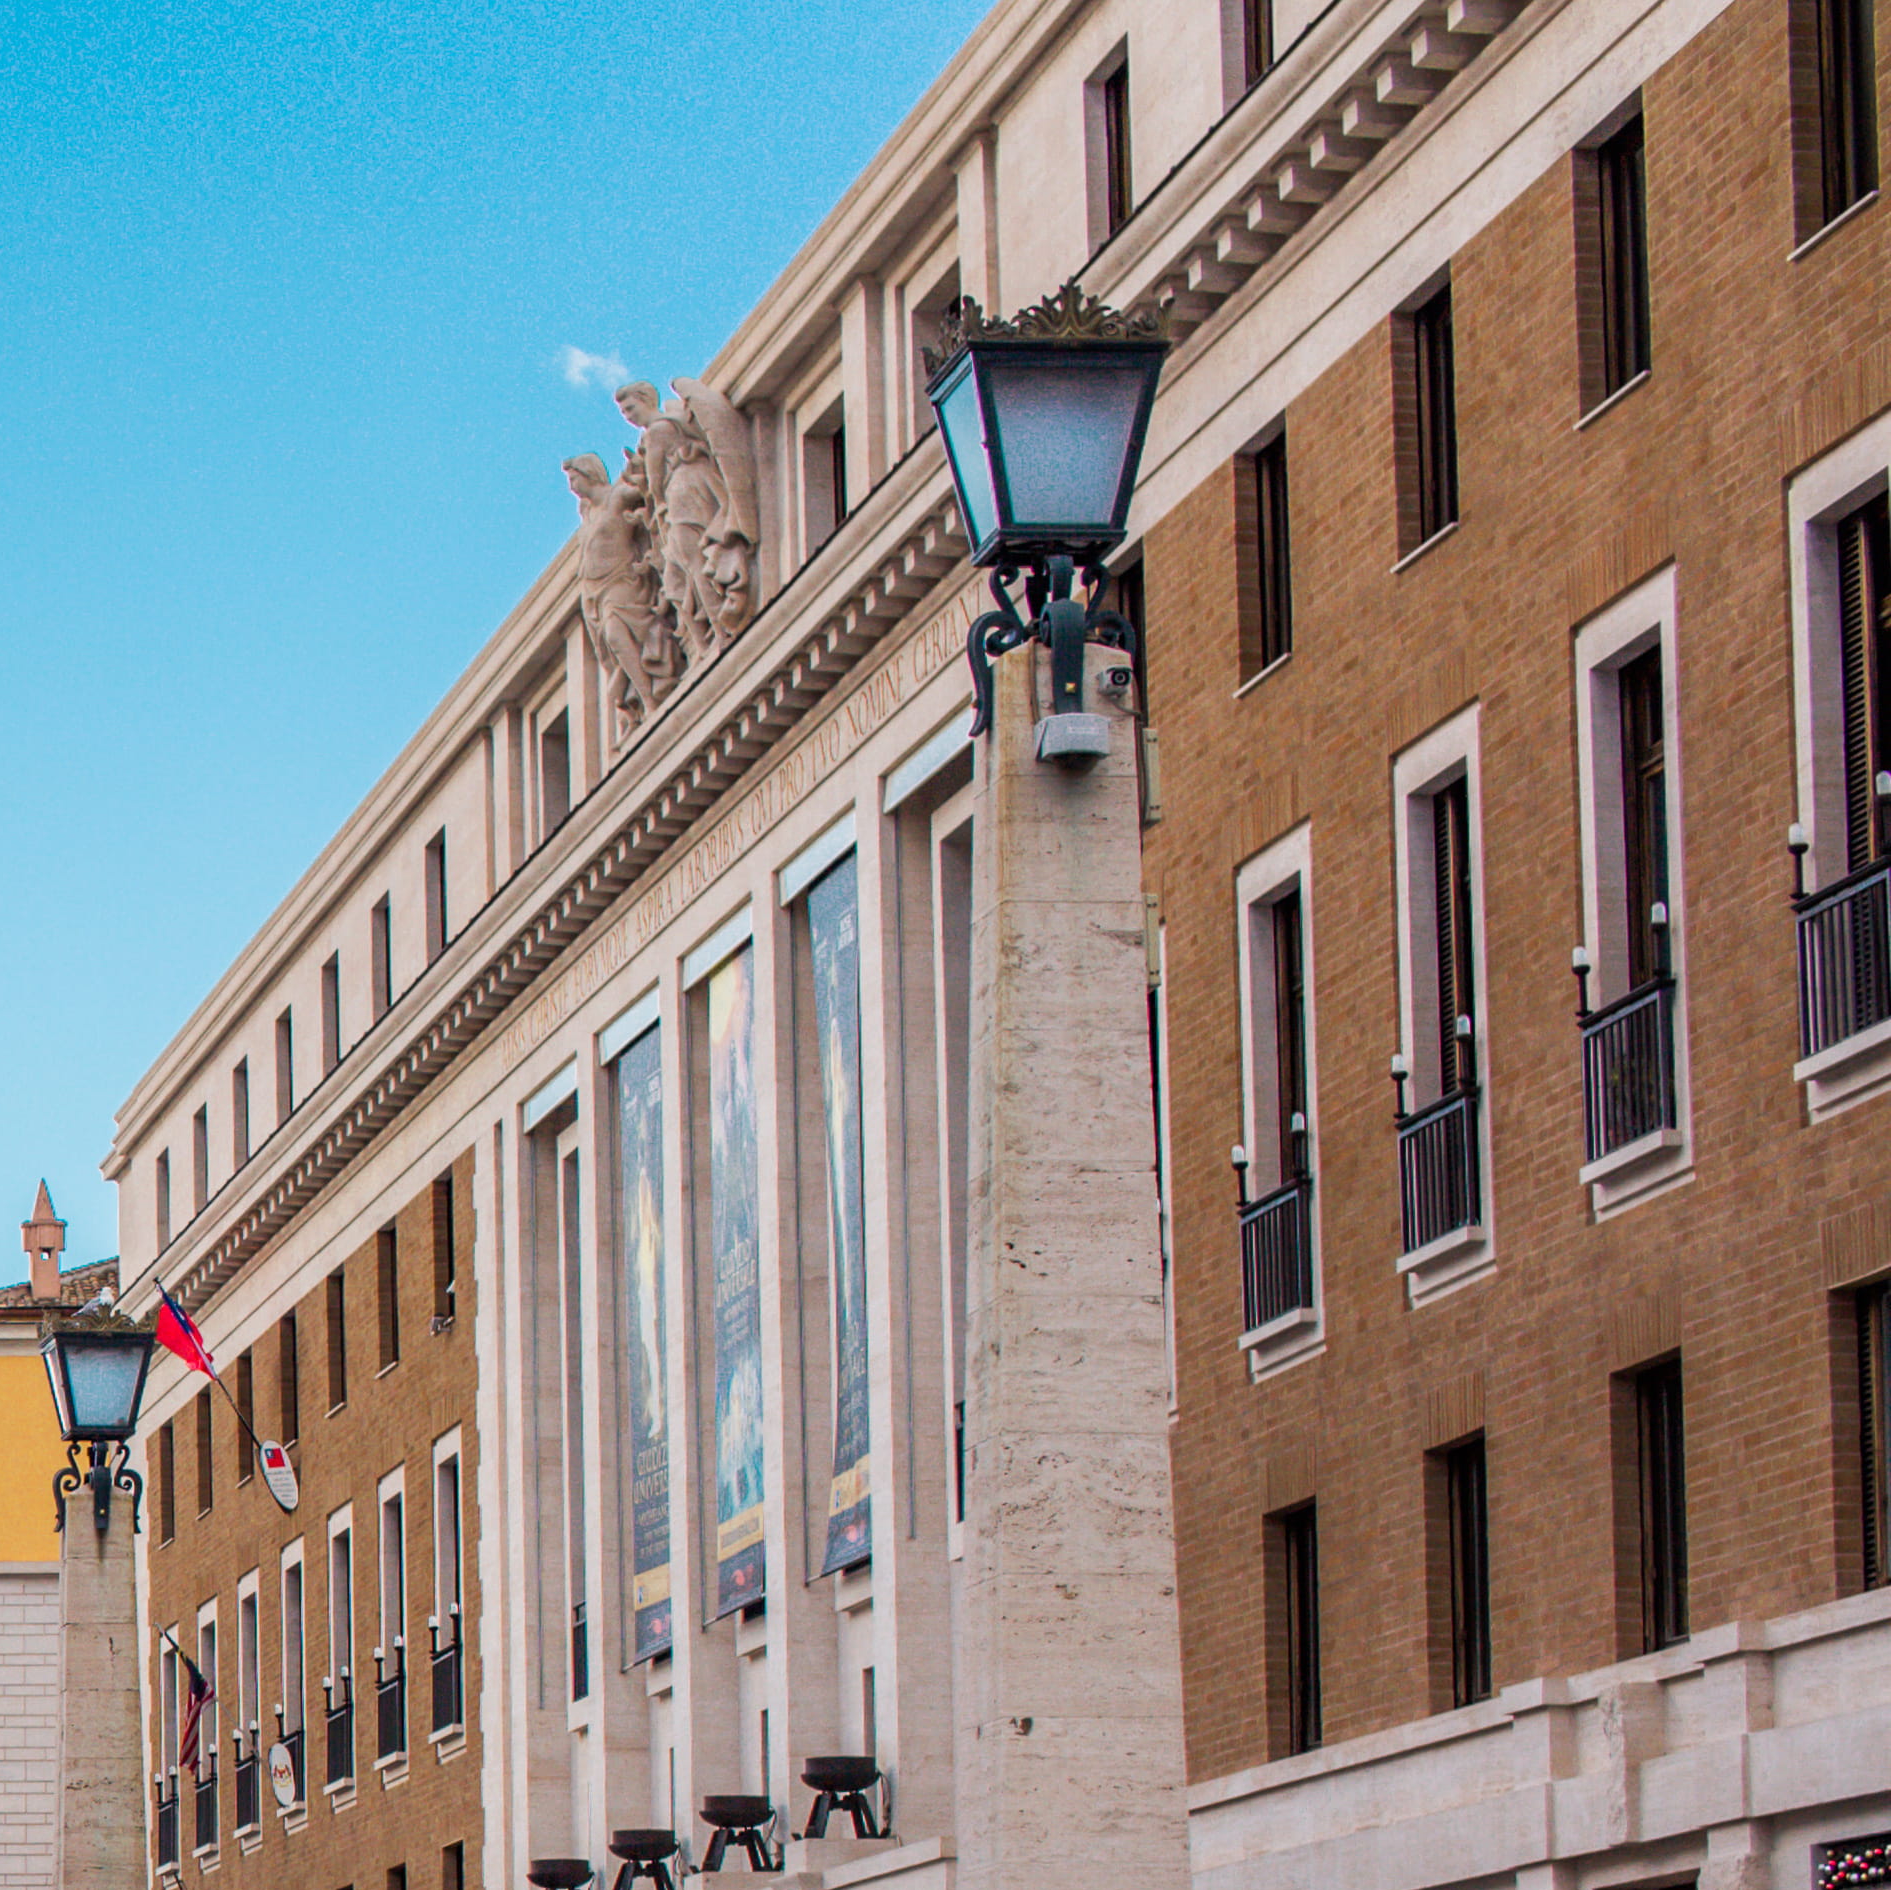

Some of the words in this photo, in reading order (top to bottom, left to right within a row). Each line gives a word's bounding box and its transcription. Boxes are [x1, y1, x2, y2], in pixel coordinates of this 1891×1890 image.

[635, 878, 674, 949] ASPIRA
[679, 811, 745, 905] LABORIBVS
[751, 780, 775, 836] QVI
[779, 752, 805, 813] PRO
[810, 719, 841, 783] TVO
[845, 654, 904, 749] NOMINE
